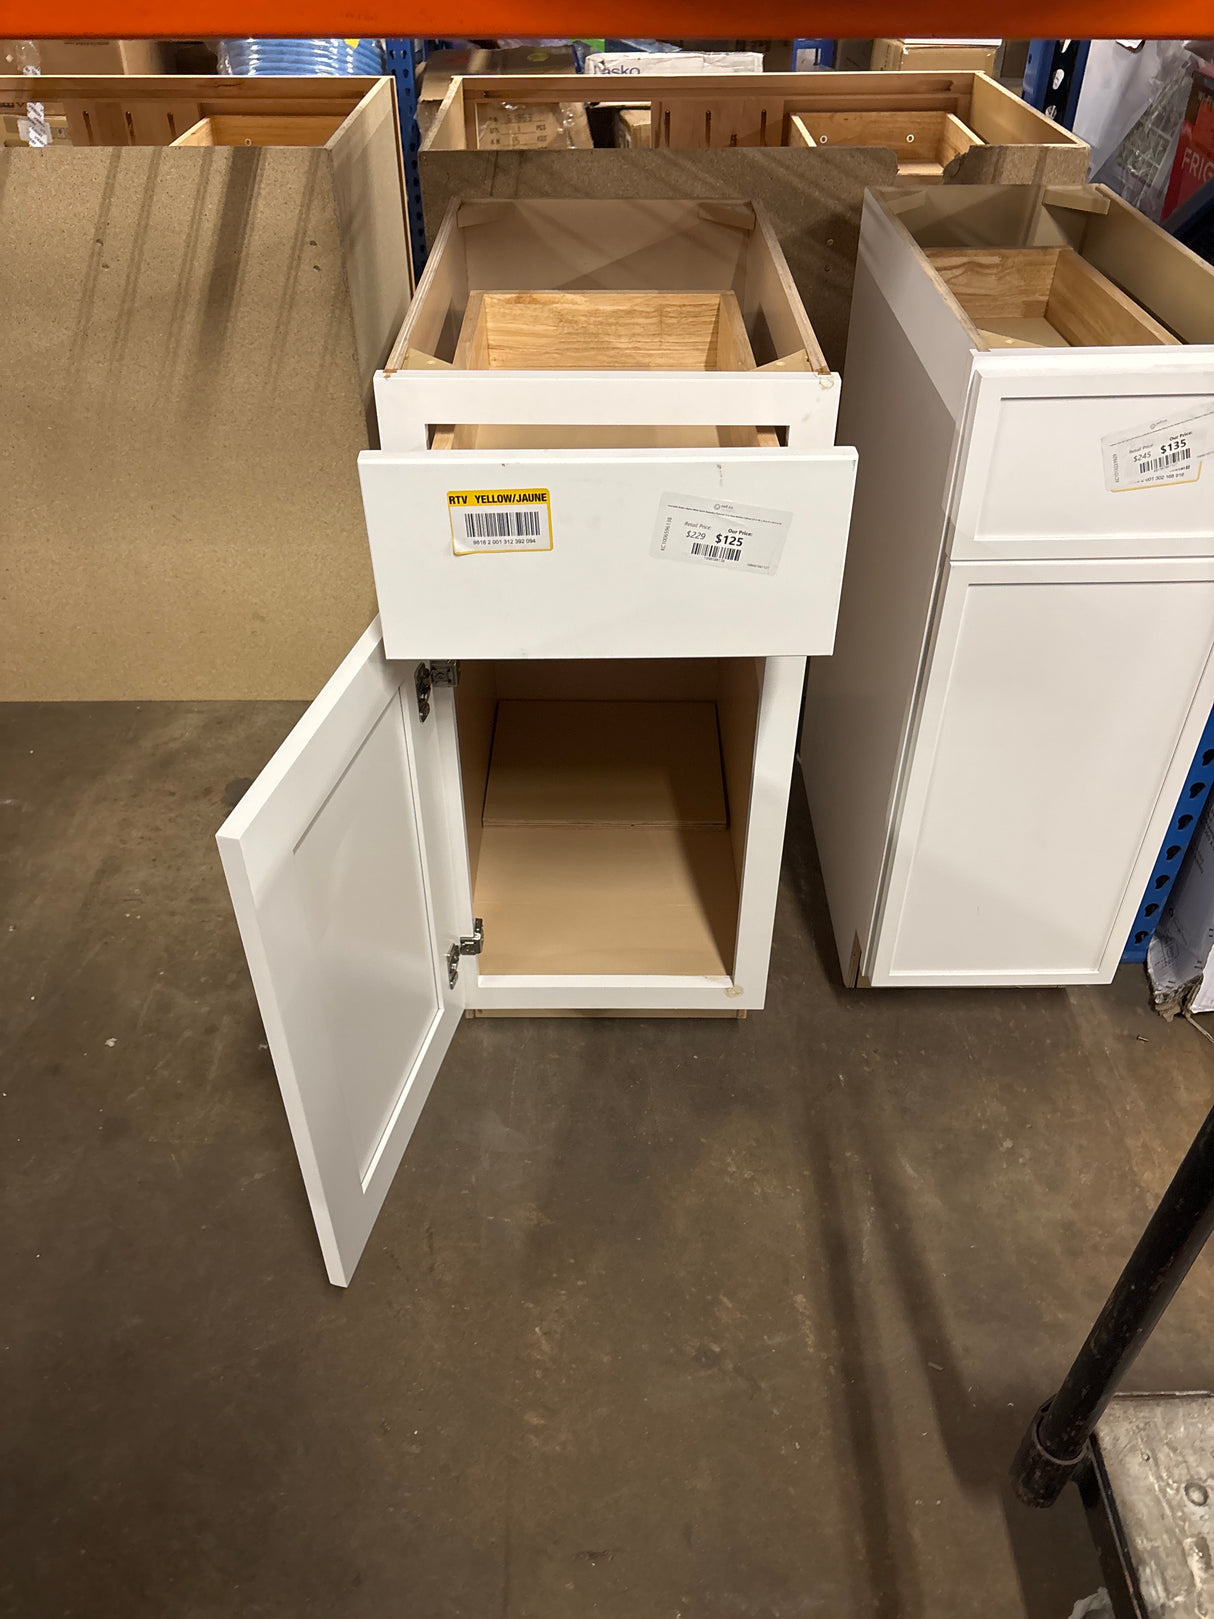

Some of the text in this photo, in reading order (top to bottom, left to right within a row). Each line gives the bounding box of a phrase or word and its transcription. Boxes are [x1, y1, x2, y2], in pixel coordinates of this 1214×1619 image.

[1160, 438, 1187, 454] $135
[1133, 451, 1152, 463] $245
[449, 493, 547, 504] RTV YELLOW/JAUNE
[685, 530, 706, 540] $229
[738, 529, 753, 537] Price:
[714, 533, 744, 547] $125
